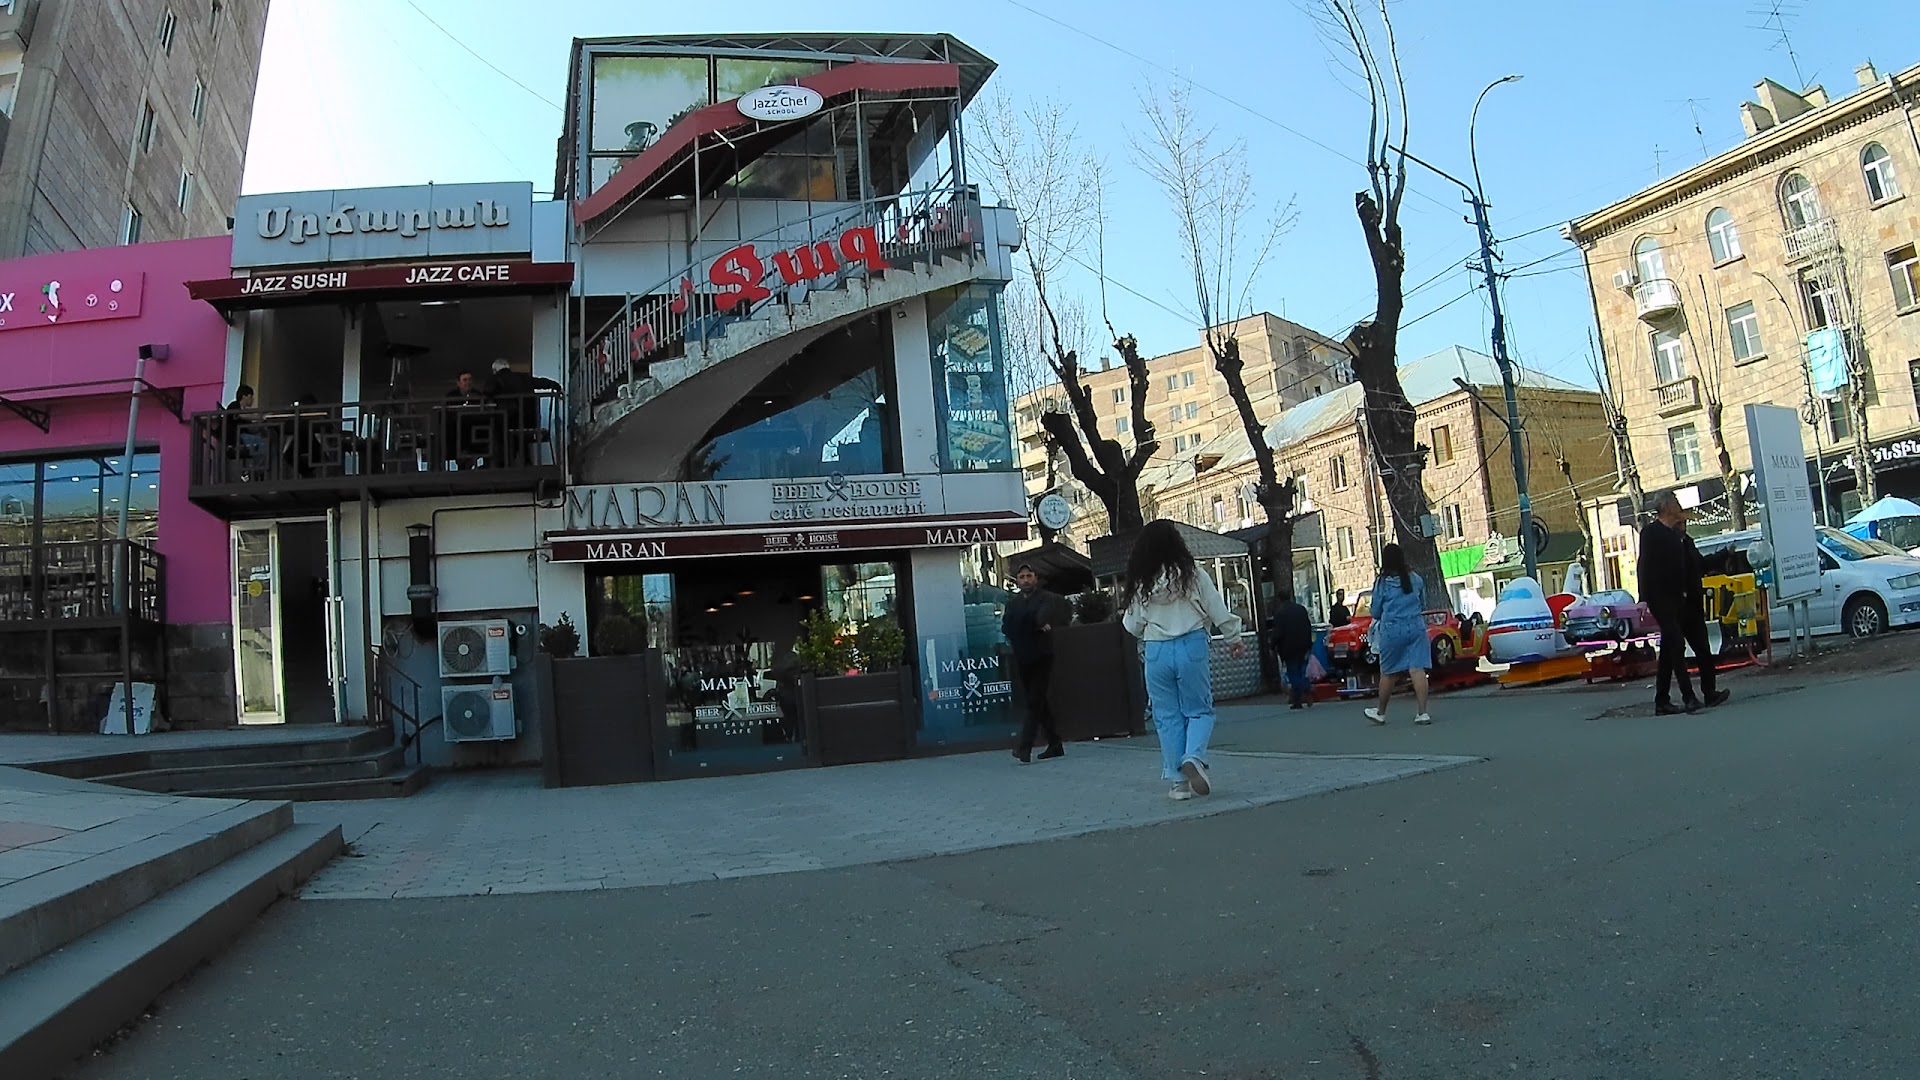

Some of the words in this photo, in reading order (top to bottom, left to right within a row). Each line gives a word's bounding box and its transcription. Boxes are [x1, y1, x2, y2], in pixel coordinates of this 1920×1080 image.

[753, 99, 778, 110] Jazz
[780, 96, 808, 107] Chef
[256, 199, 510, 244] Սրճարան
[240, 276, 286, 294] JAZZ
[290, 272, 347, 290] SUSHI
[405, 267, 453, 284] JAZZ
[457, 265, 510, 282] CAFE
[773, 483, 824, 500] BEER
[850, 479, 921, 497] HOUSE
[566, 482, 728, 530] MARAN
[770, 502, 815, 521] café
[821, 500, 927, 518] restaurant
[765, 536, 789, 545] BEER
[809, 533, 839, 543] HOUSE
[926, 527, 998, 545] MARAN
[586, 542, 667, 559] MARAN
[941, 656, 999, 672] MARAN
[938, 689, 961, 698] BEER
[983, 683, 1012, 693] HOUSE
[695, 708, 720, 717] BEER
[696, 718, 780, 730] RESTAURANT
